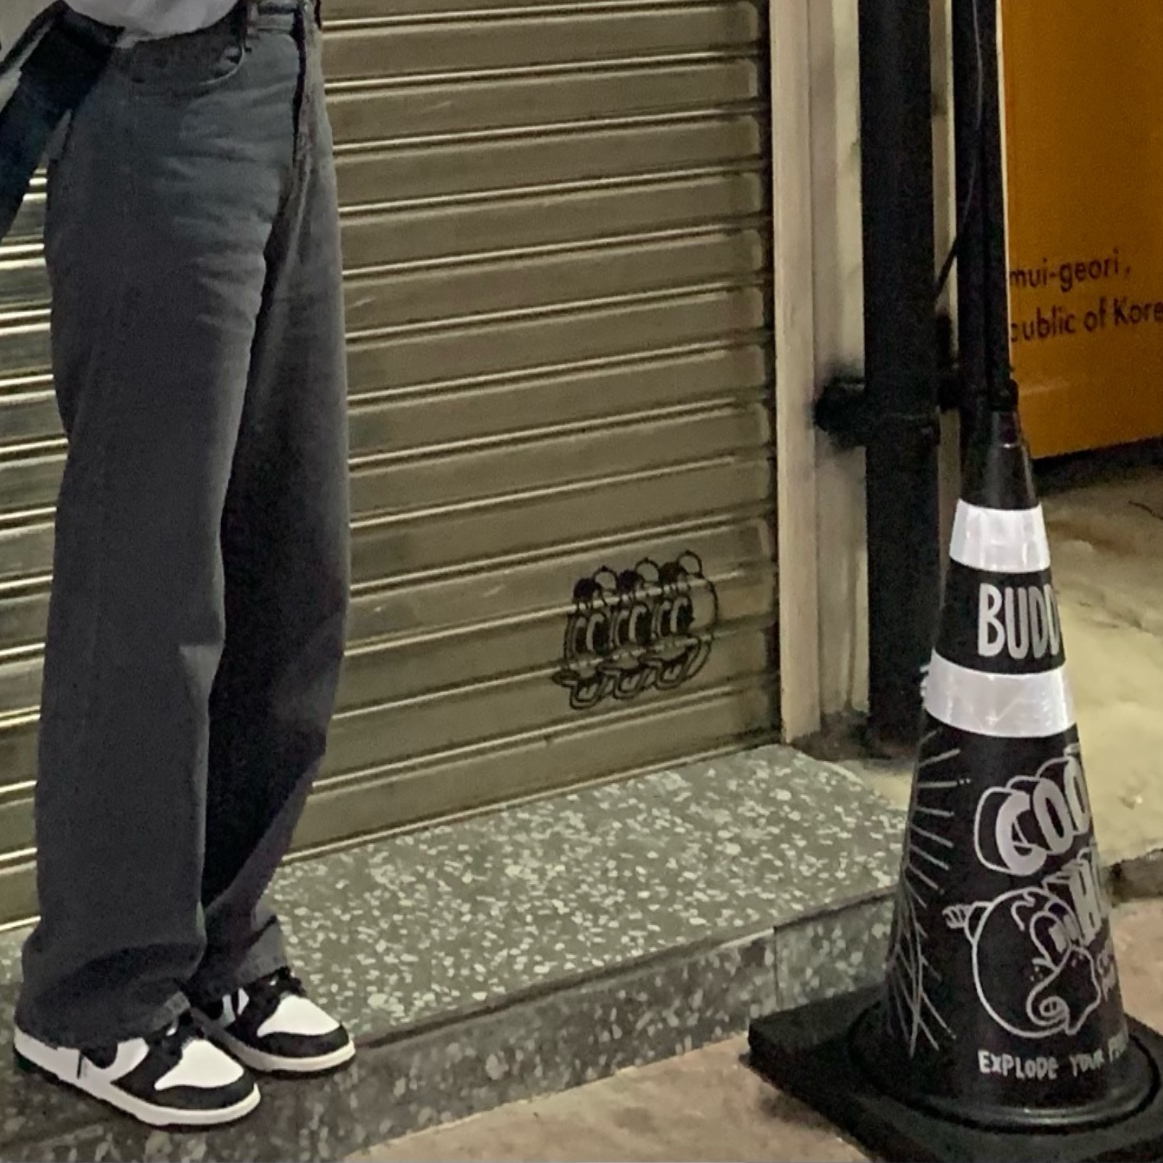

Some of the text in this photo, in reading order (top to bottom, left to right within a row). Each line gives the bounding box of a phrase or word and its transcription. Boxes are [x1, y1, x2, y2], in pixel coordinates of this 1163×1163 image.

[1010, 247, 1132, 293] mui-geori,
[1084, 296, 1106, 333] of
[1113, 296, 1163, 326] Kore
[977, 583, 1061, 659] BUDD
